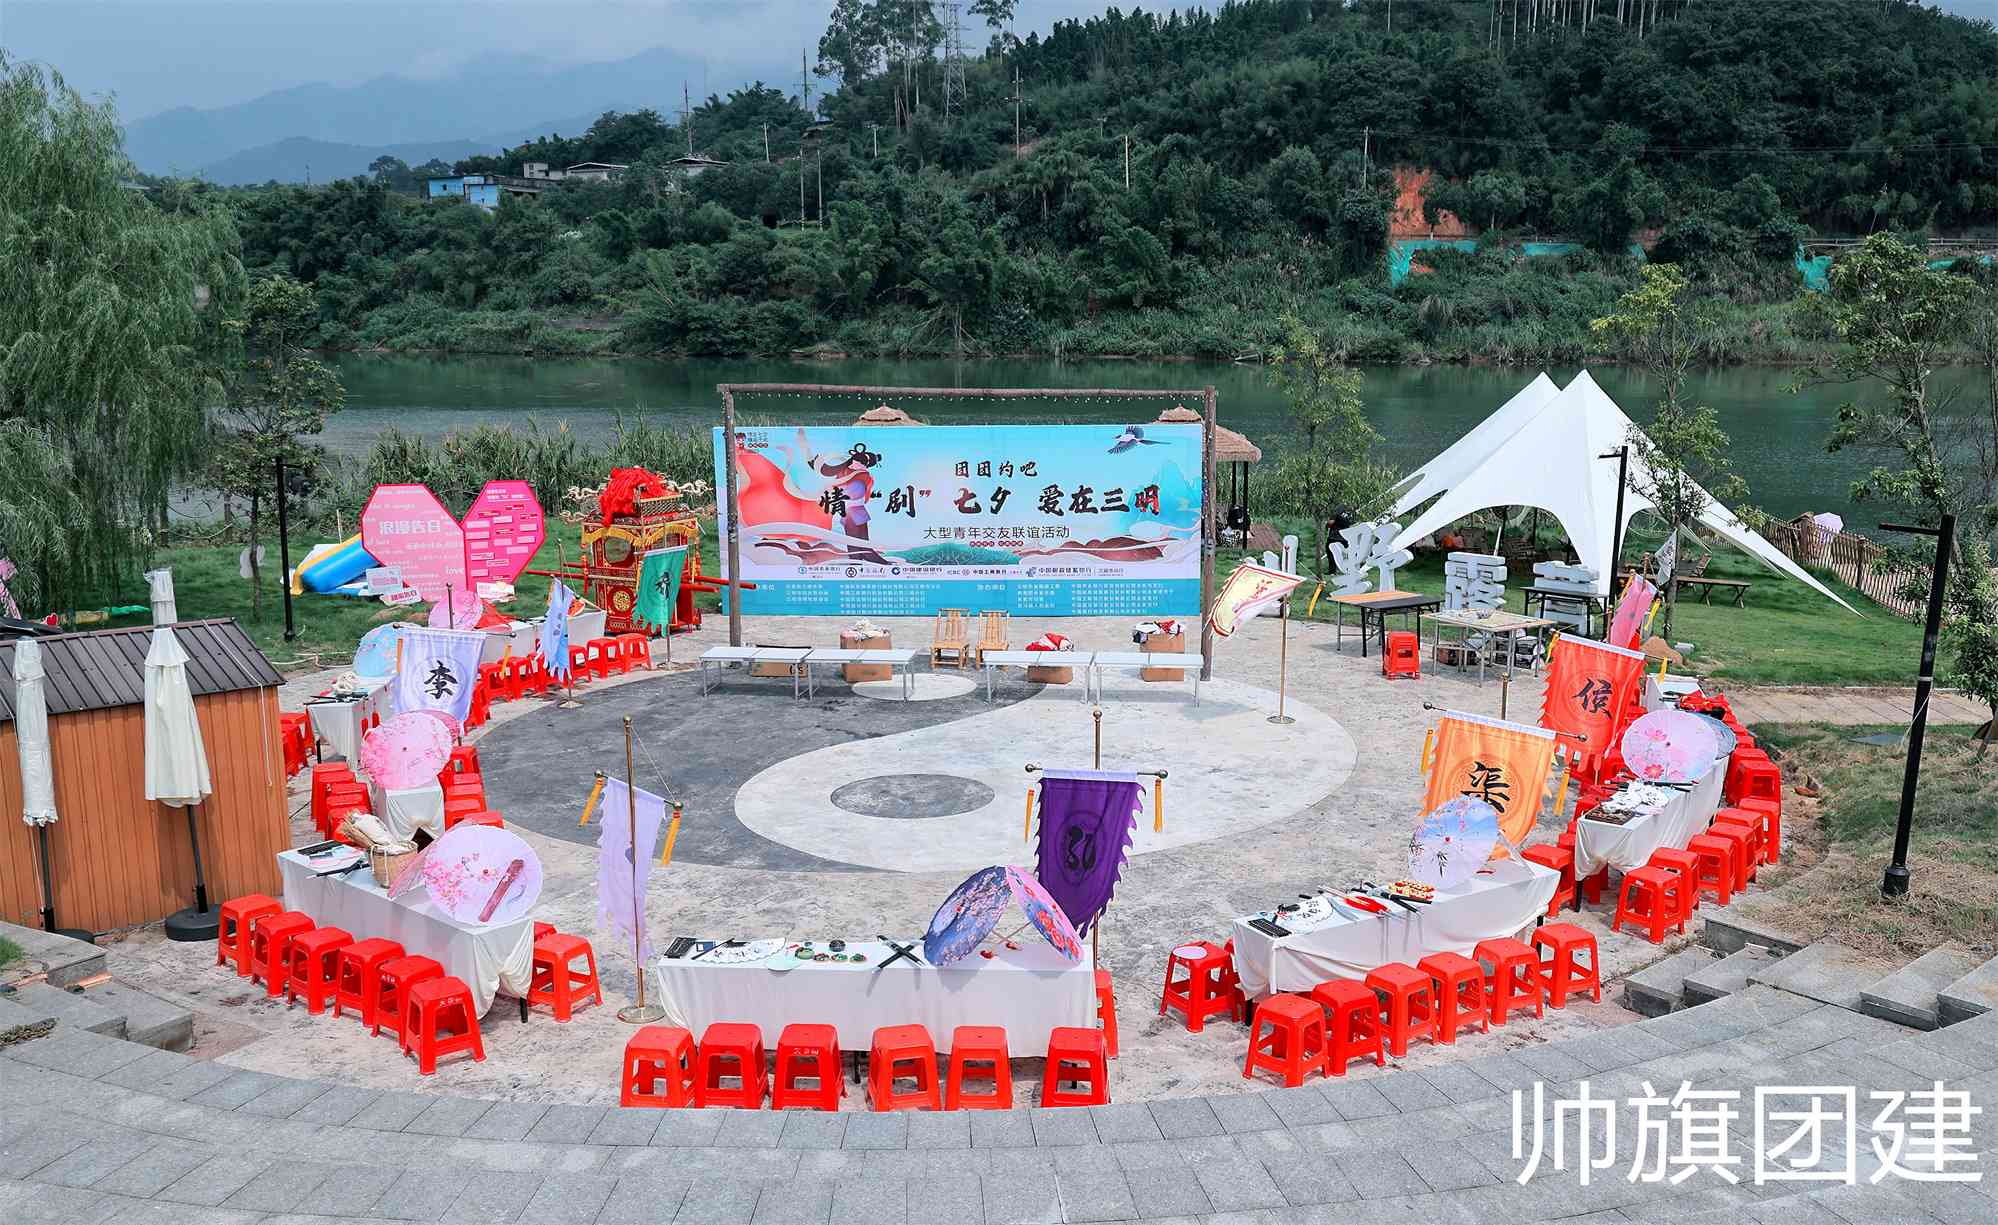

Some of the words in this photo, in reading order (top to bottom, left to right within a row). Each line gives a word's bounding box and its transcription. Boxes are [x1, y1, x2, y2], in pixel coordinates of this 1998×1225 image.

[955, 460, 1038, 478] 团团约吧
[953, 485, 1013, 516] 七夕
[1038, 483, 1161, 517] 爱在三明
[922, 526, 1070, 539] 大型青年交友联谊活动
[424, 660, 458, 699] 李
